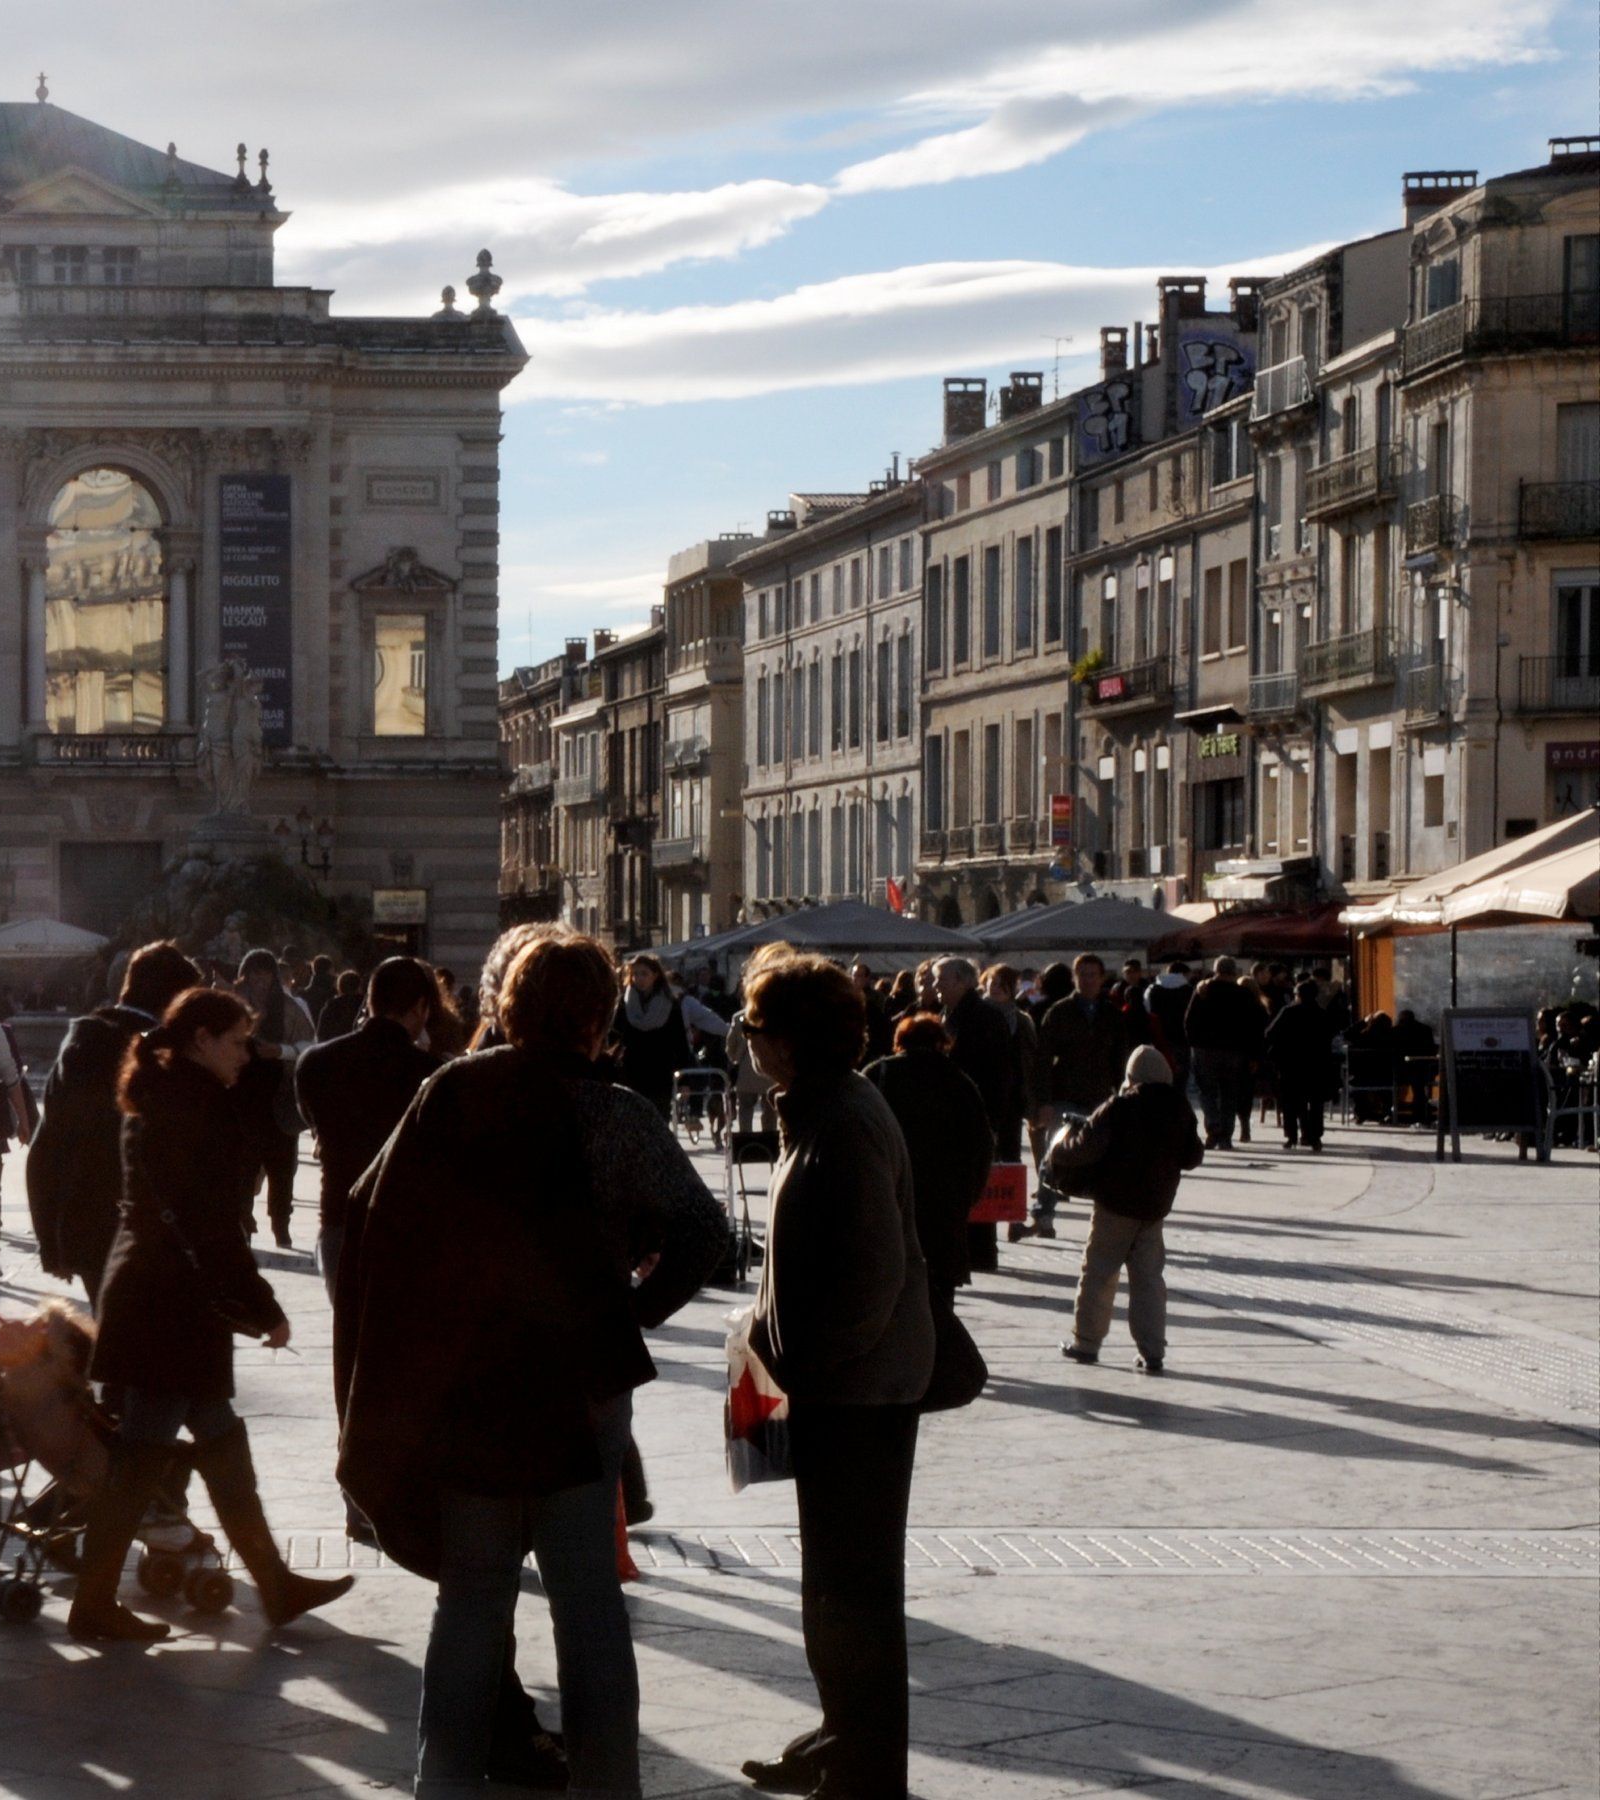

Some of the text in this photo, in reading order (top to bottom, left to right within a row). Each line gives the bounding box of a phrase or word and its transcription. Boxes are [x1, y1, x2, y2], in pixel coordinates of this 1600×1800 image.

[223, 575, 280, 586] RIGOLETTO
[223, 605, 265, 616] MANON
[223, 616, 267, 627] LESCAUT
[248, 668, 286, 679] ARMEN
